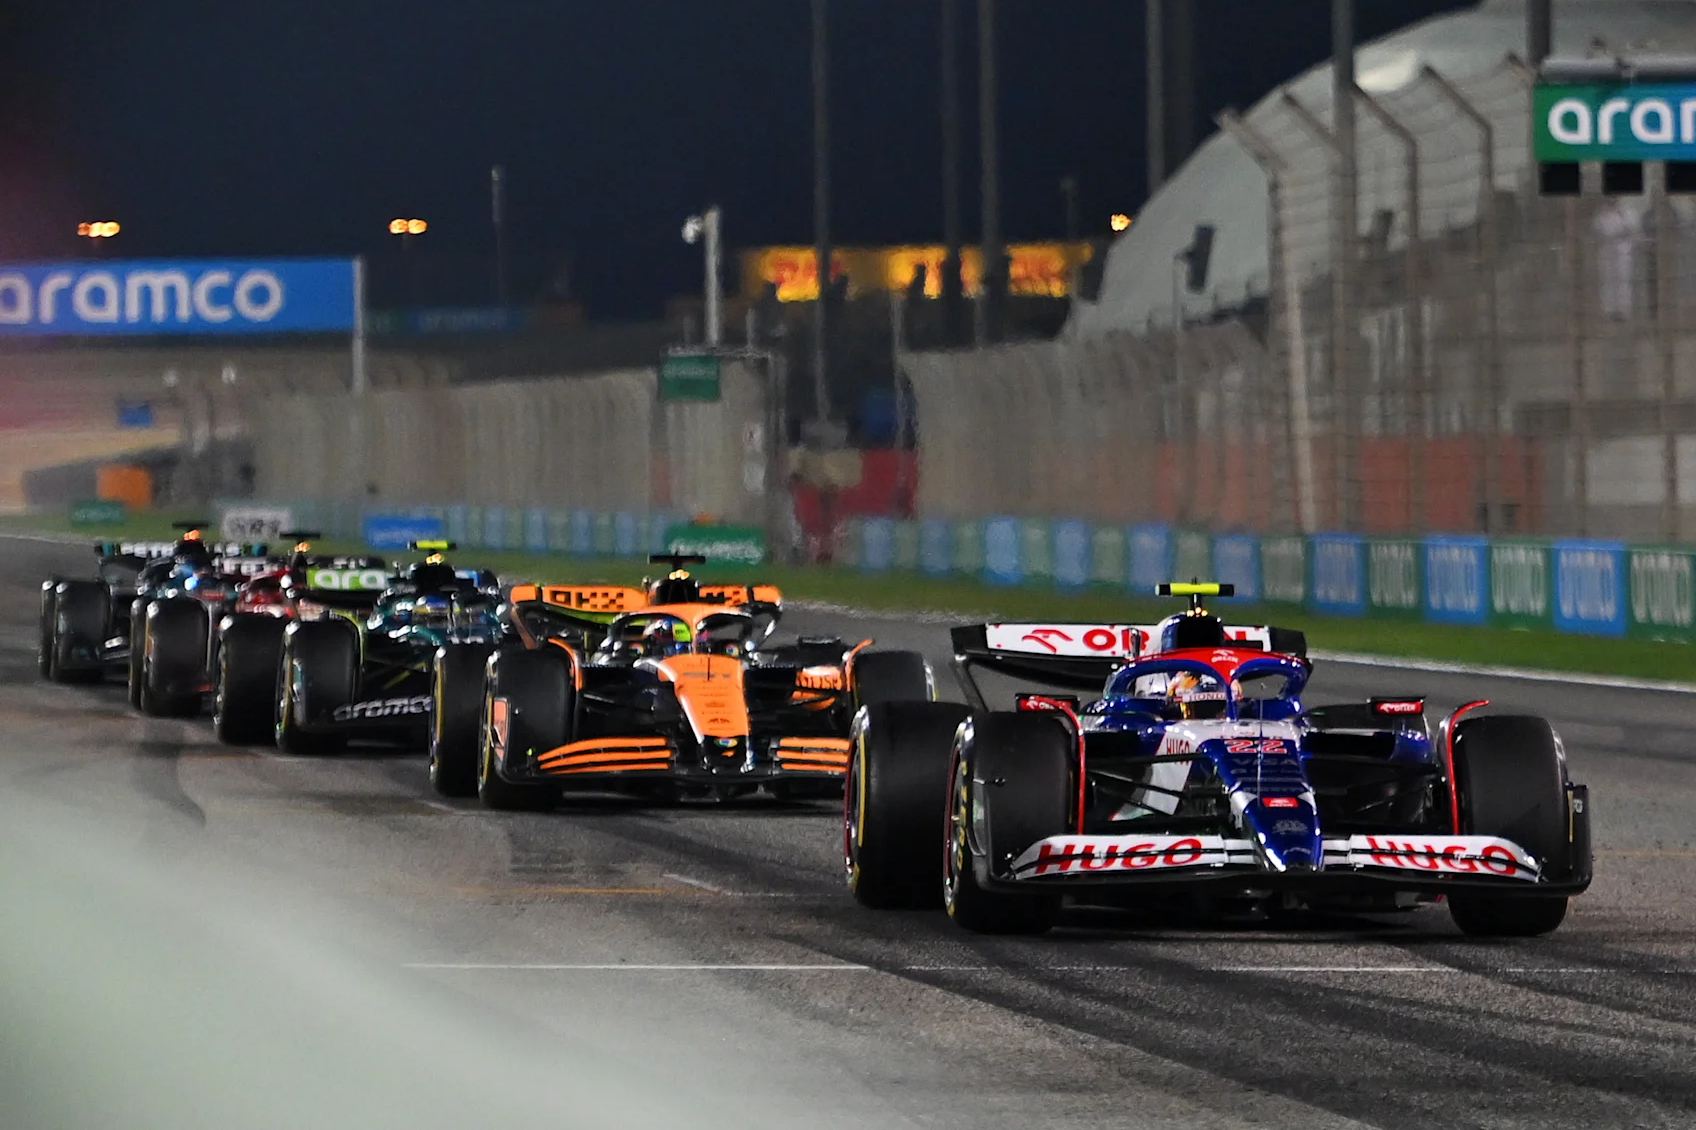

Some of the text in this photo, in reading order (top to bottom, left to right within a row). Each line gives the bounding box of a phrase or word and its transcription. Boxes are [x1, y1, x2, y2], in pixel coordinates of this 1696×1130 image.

[0, 269, 283, 325] aramco
[1224, 739, 1288, 754] 22
[1035, 837, 1203, 874] HUGO
[1366, 836, 1519, 876] HUGO
